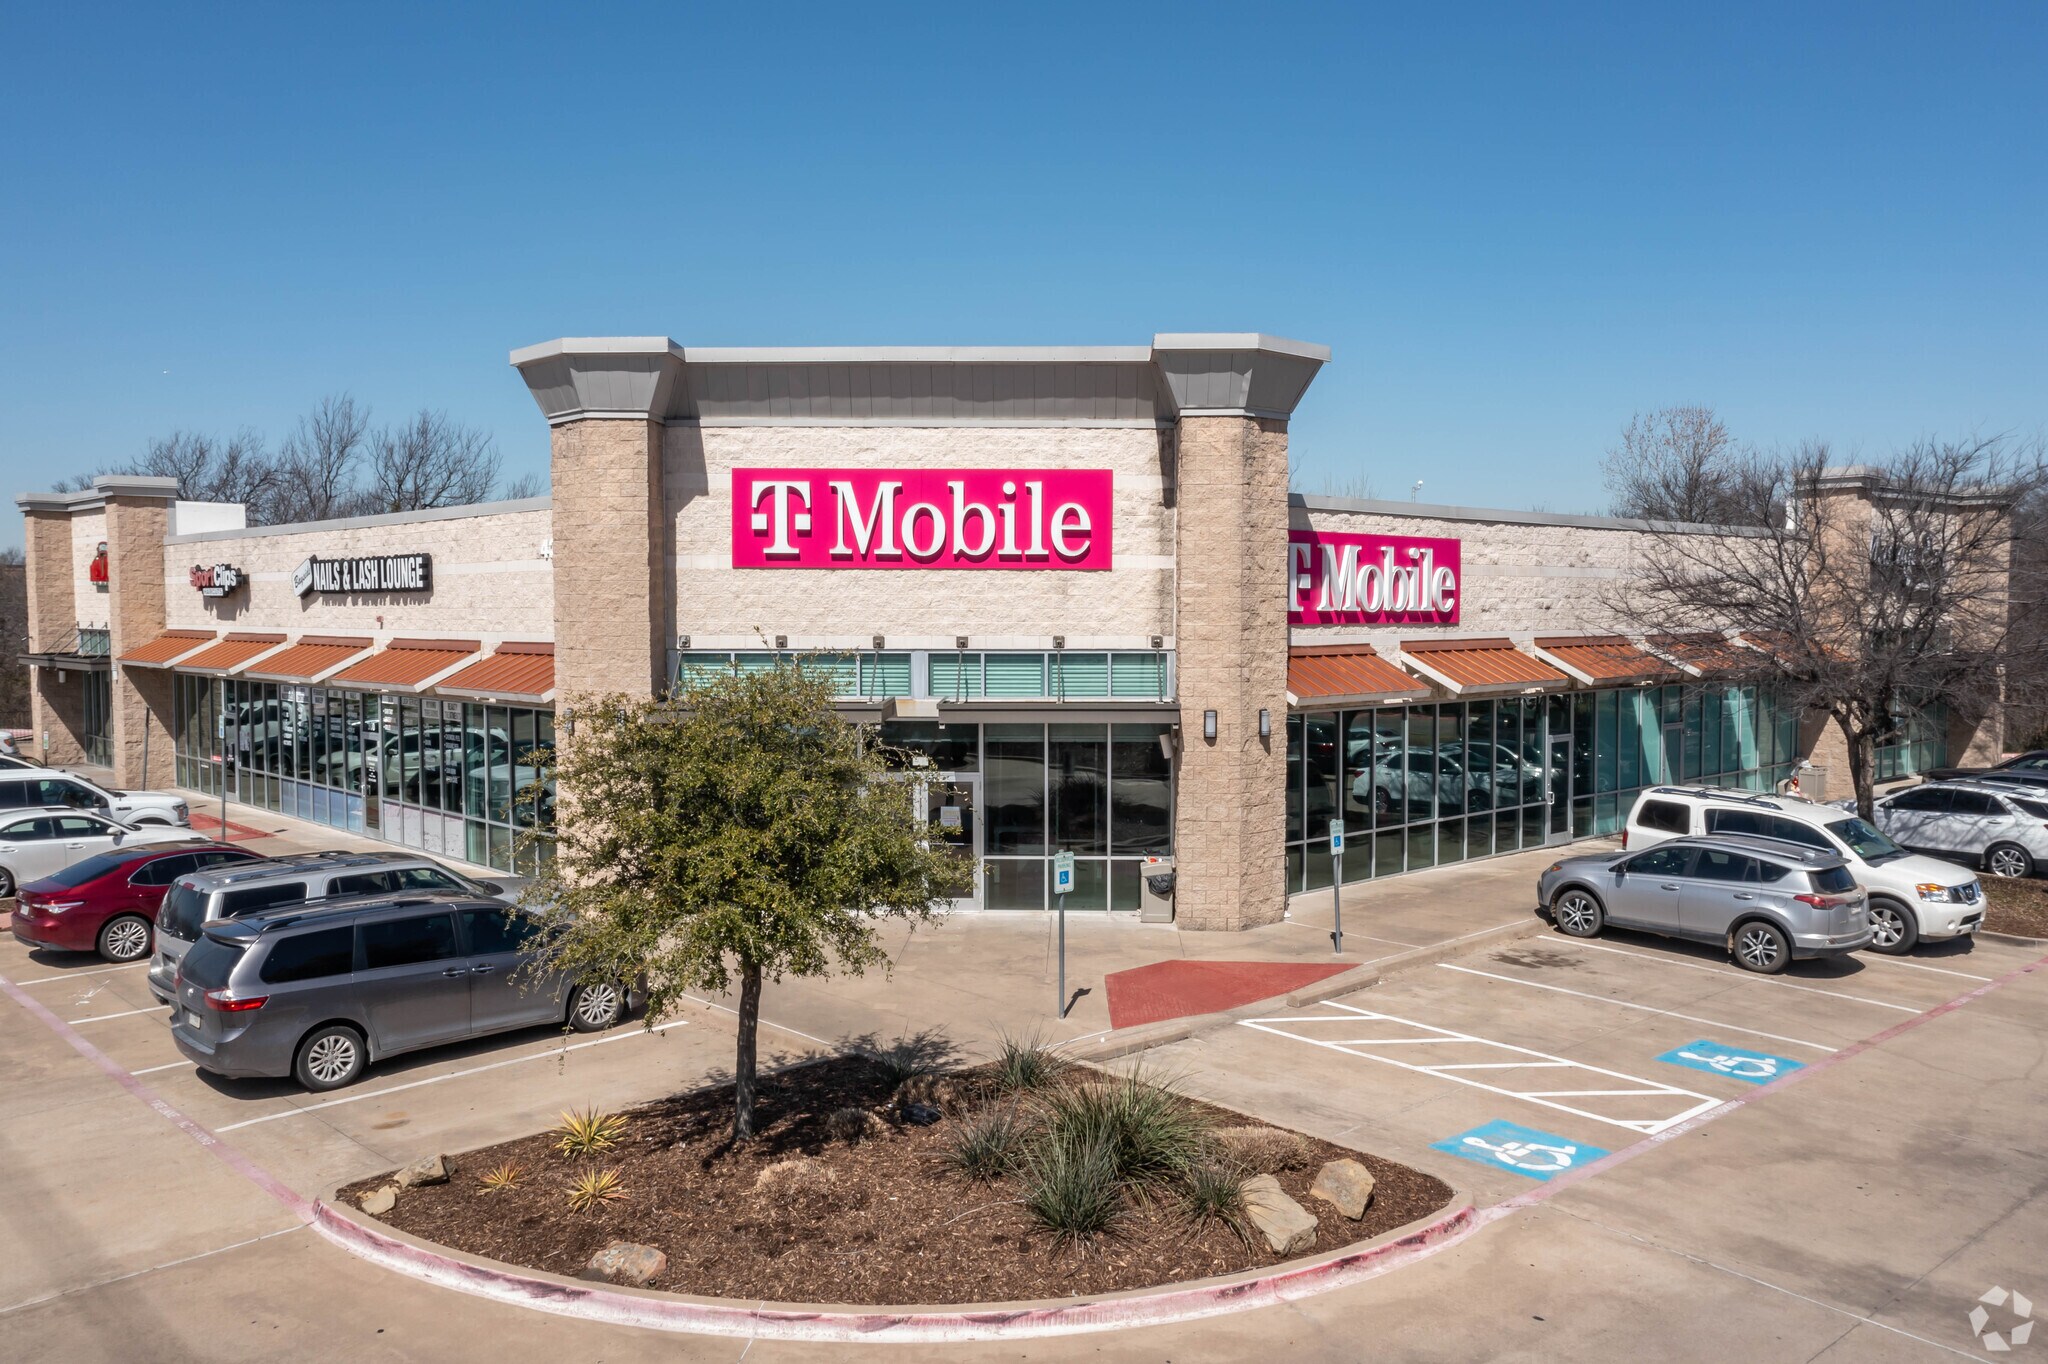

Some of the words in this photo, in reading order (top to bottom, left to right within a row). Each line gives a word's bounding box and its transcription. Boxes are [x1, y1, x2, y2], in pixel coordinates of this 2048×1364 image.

[751, 481, 811, 554] T
[829, 481, 1092, 556] Mobile
[313, 561, 340, 591] NAILS
[342, 560, 351, 591] &
[352, 559, 379, 590] LASH
[380, 556, 424, 589] LOUNGE
[1316, 543, 1456, 613] Mobile
